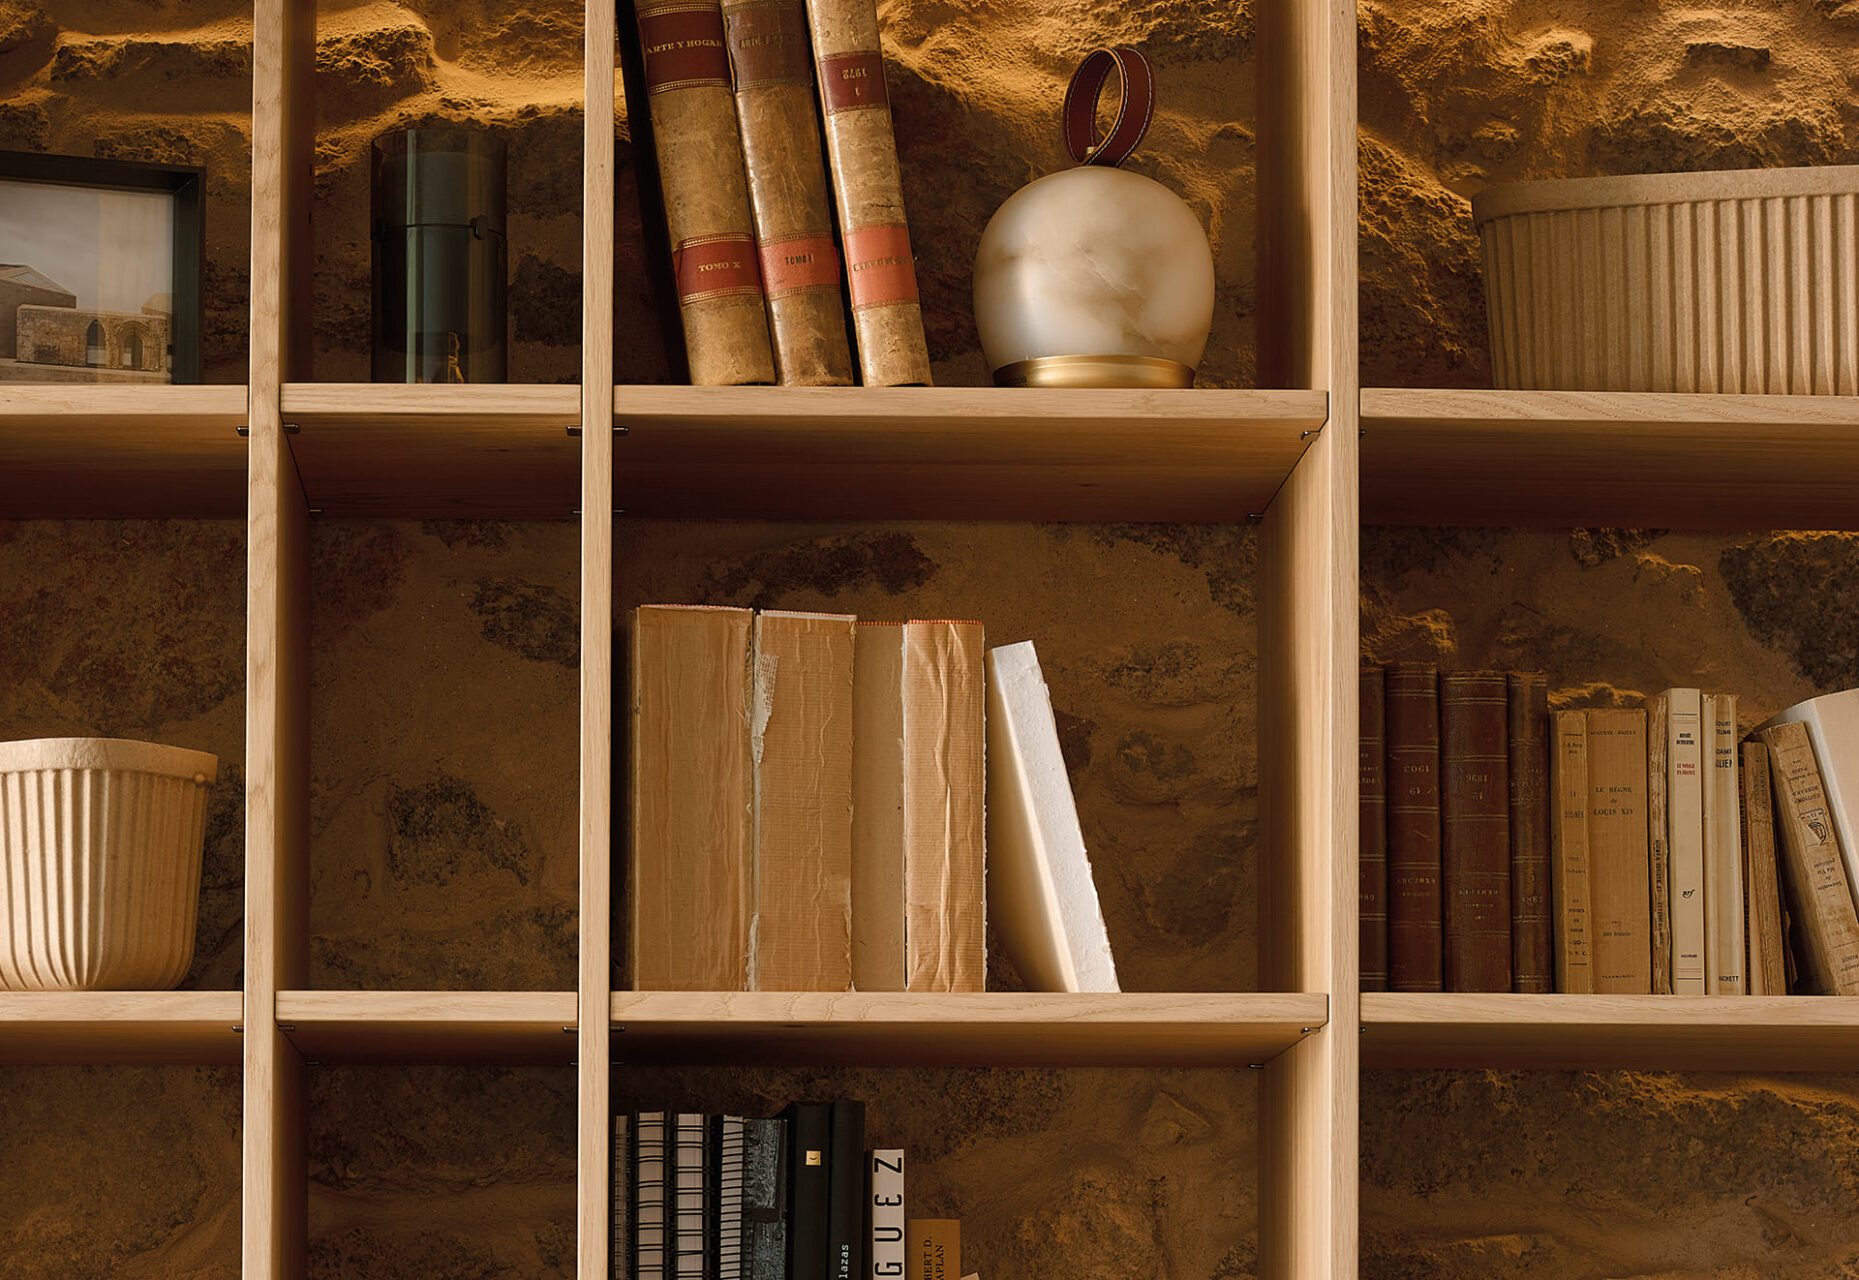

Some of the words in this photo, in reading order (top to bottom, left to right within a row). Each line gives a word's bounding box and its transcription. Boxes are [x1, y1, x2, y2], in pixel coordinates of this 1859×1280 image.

[648, 43, 675, 54] ARTE
[677, 41, 684, 49] Y
[687, 39, 723, 48] HOGAR
[842, 67, 868, 80] 1972
[698, 261, 729, 272] TOMO
[732, 261, 741, 270] X
[1402, 764, 1429, 773] 1903
[923, 1236, 933, 1248] D.
